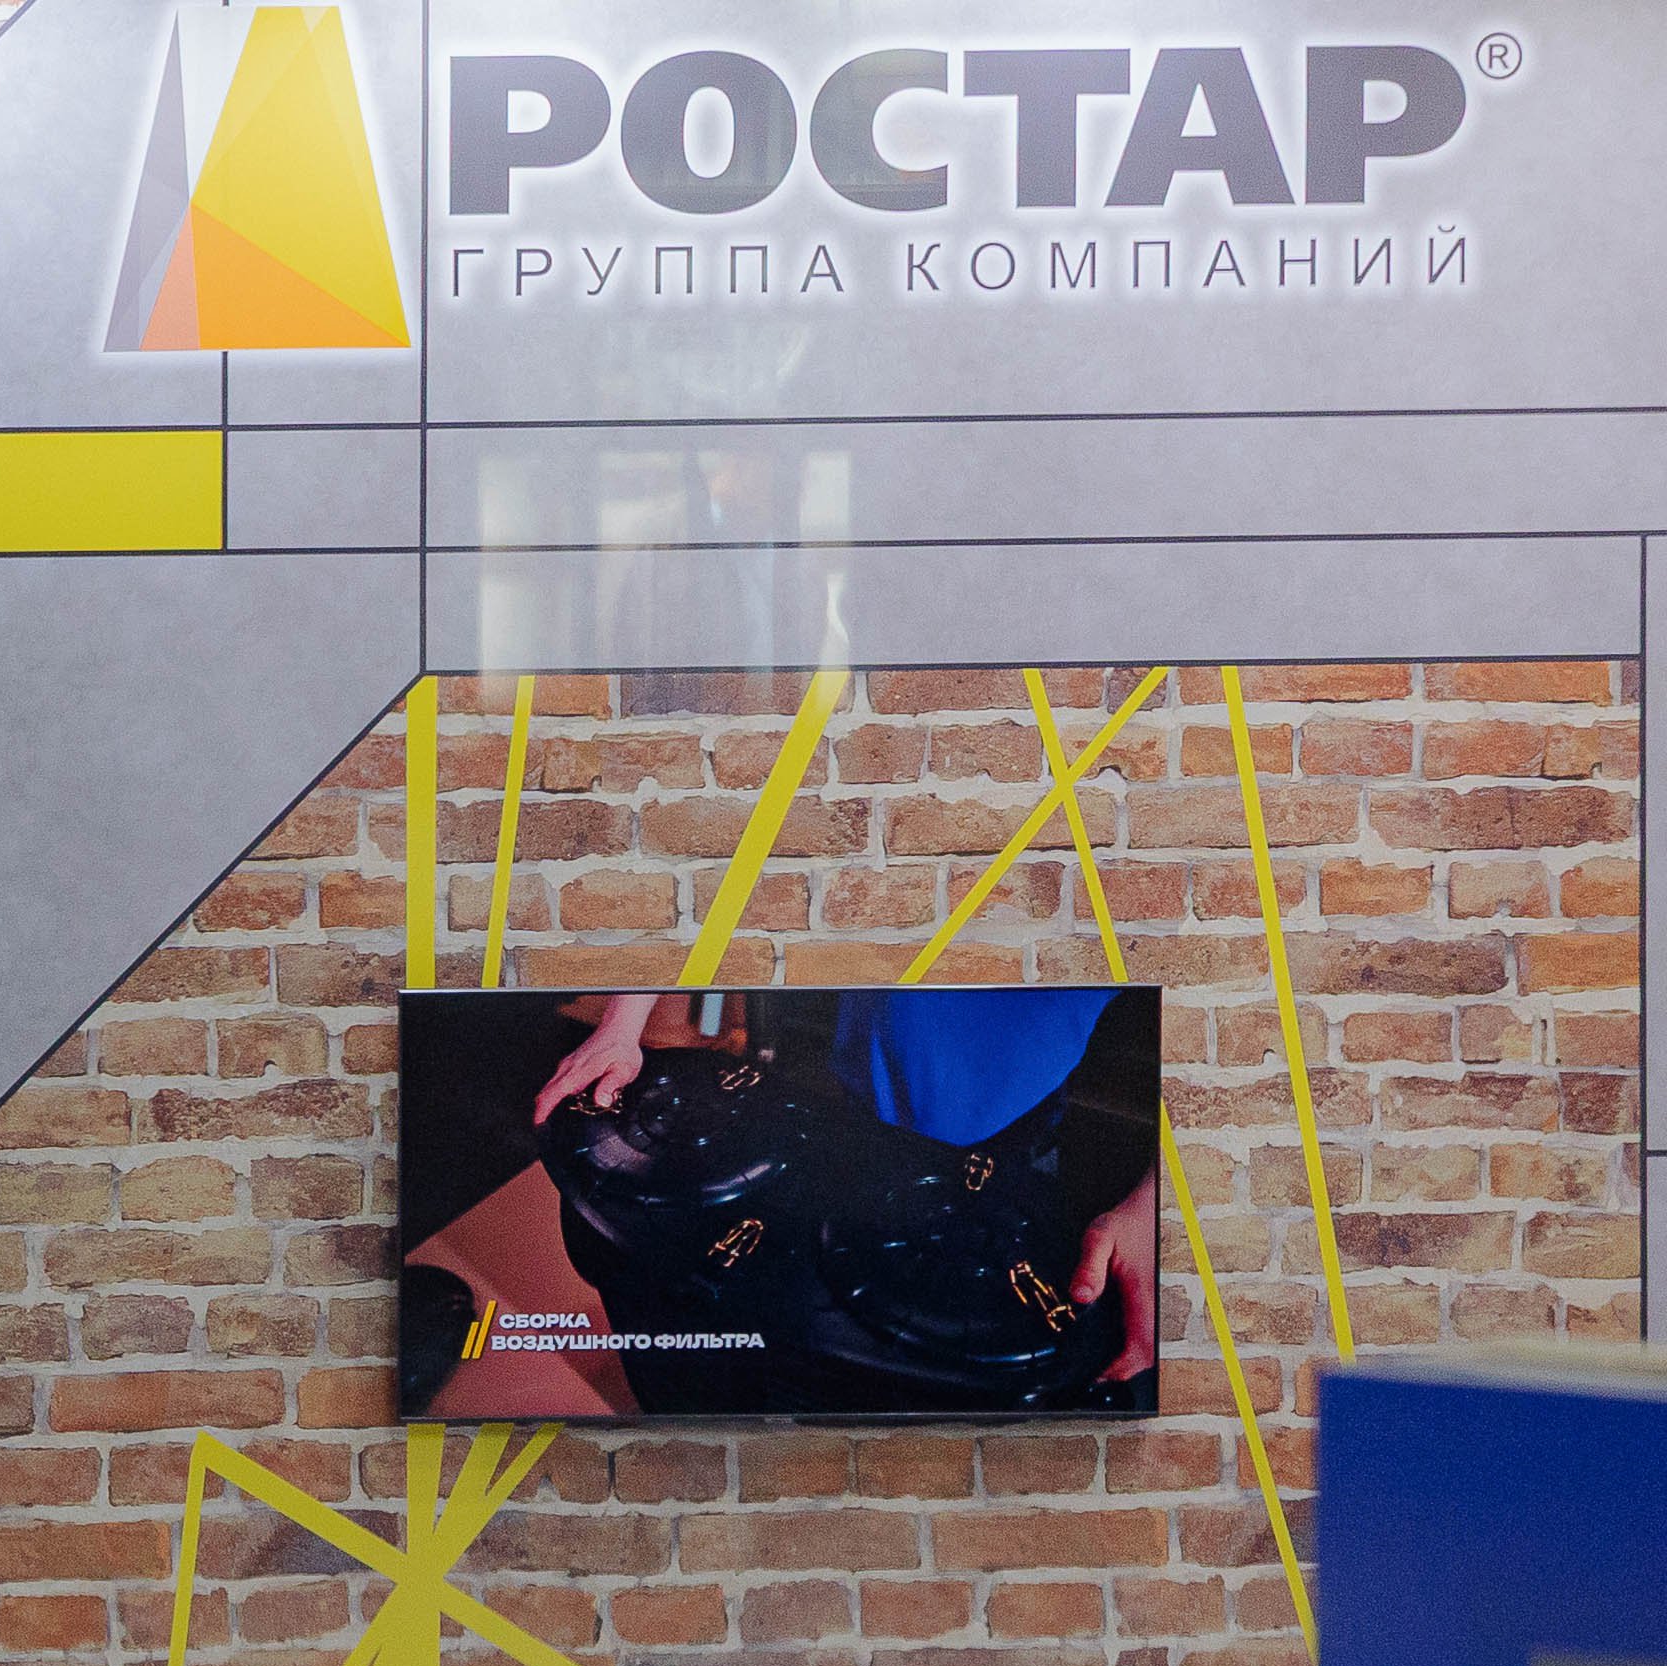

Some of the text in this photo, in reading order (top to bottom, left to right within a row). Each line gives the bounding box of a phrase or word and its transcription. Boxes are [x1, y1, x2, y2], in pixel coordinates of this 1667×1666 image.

[449, 45, 1467, 214] РОСТАР
[452, 224, 1468, 297] ГРУППА КОМПАНИЙ
[491, 1332, 766, 1351] ВОЗДУШНОГО ФИЛЬТРА
[498, 1313, 591, 1329] СБОРКА
